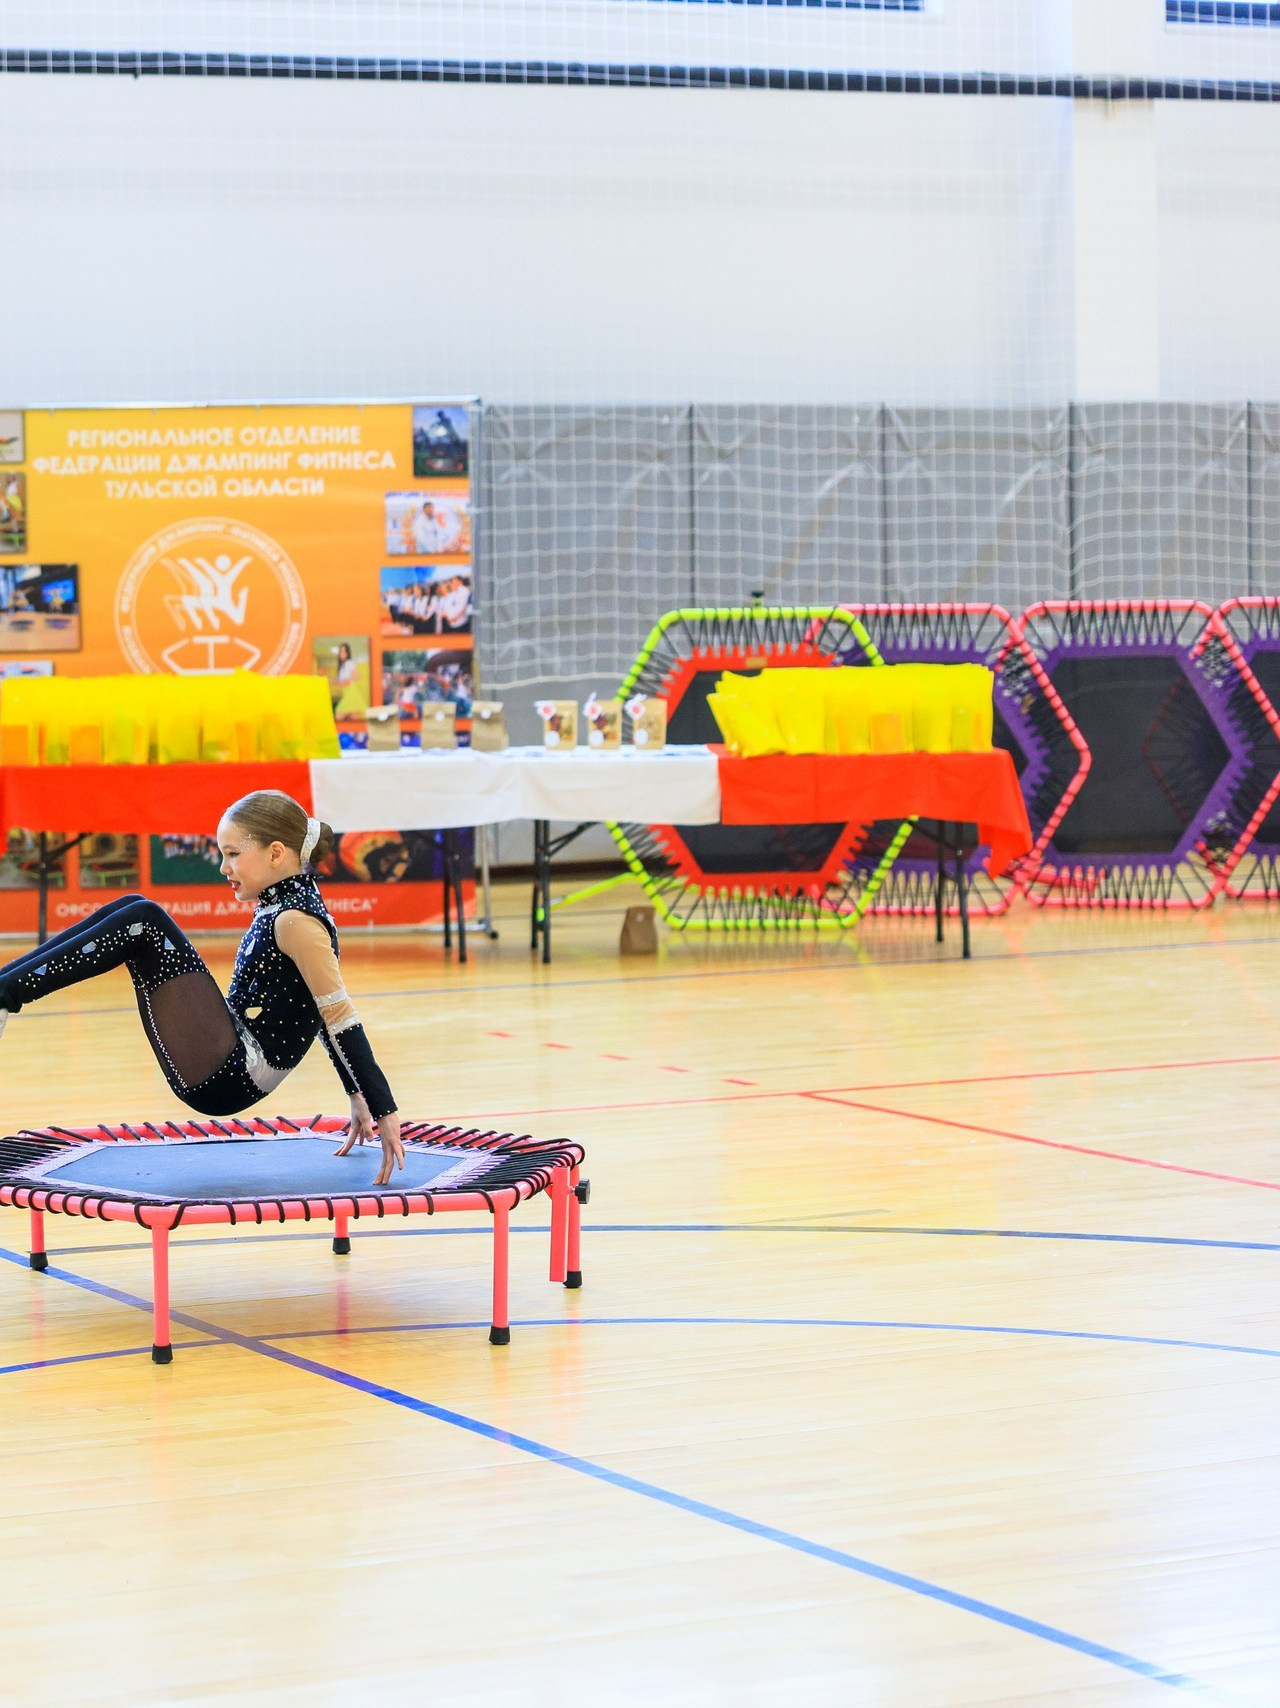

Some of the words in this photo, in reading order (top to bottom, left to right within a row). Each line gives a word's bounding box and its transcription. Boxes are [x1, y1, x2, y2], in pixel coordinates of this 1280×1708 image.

[67, 427, 234, 449] РЕГИОНАЛЬНОЕ
[239, 425, 362, 447] ОТДЕЛЕНИЕ
[32, 455, 162, 476] ФЕДЕРАЦИИ
[166, 452, 292, 474] ДЖАМПИНГ
[297, 450, 397, 471] ФИТНЕСА
[105, 475, 218, 499] ТУЛЬСКОЙ
[223, 476, 326, 498] ОБЛАСТИ
